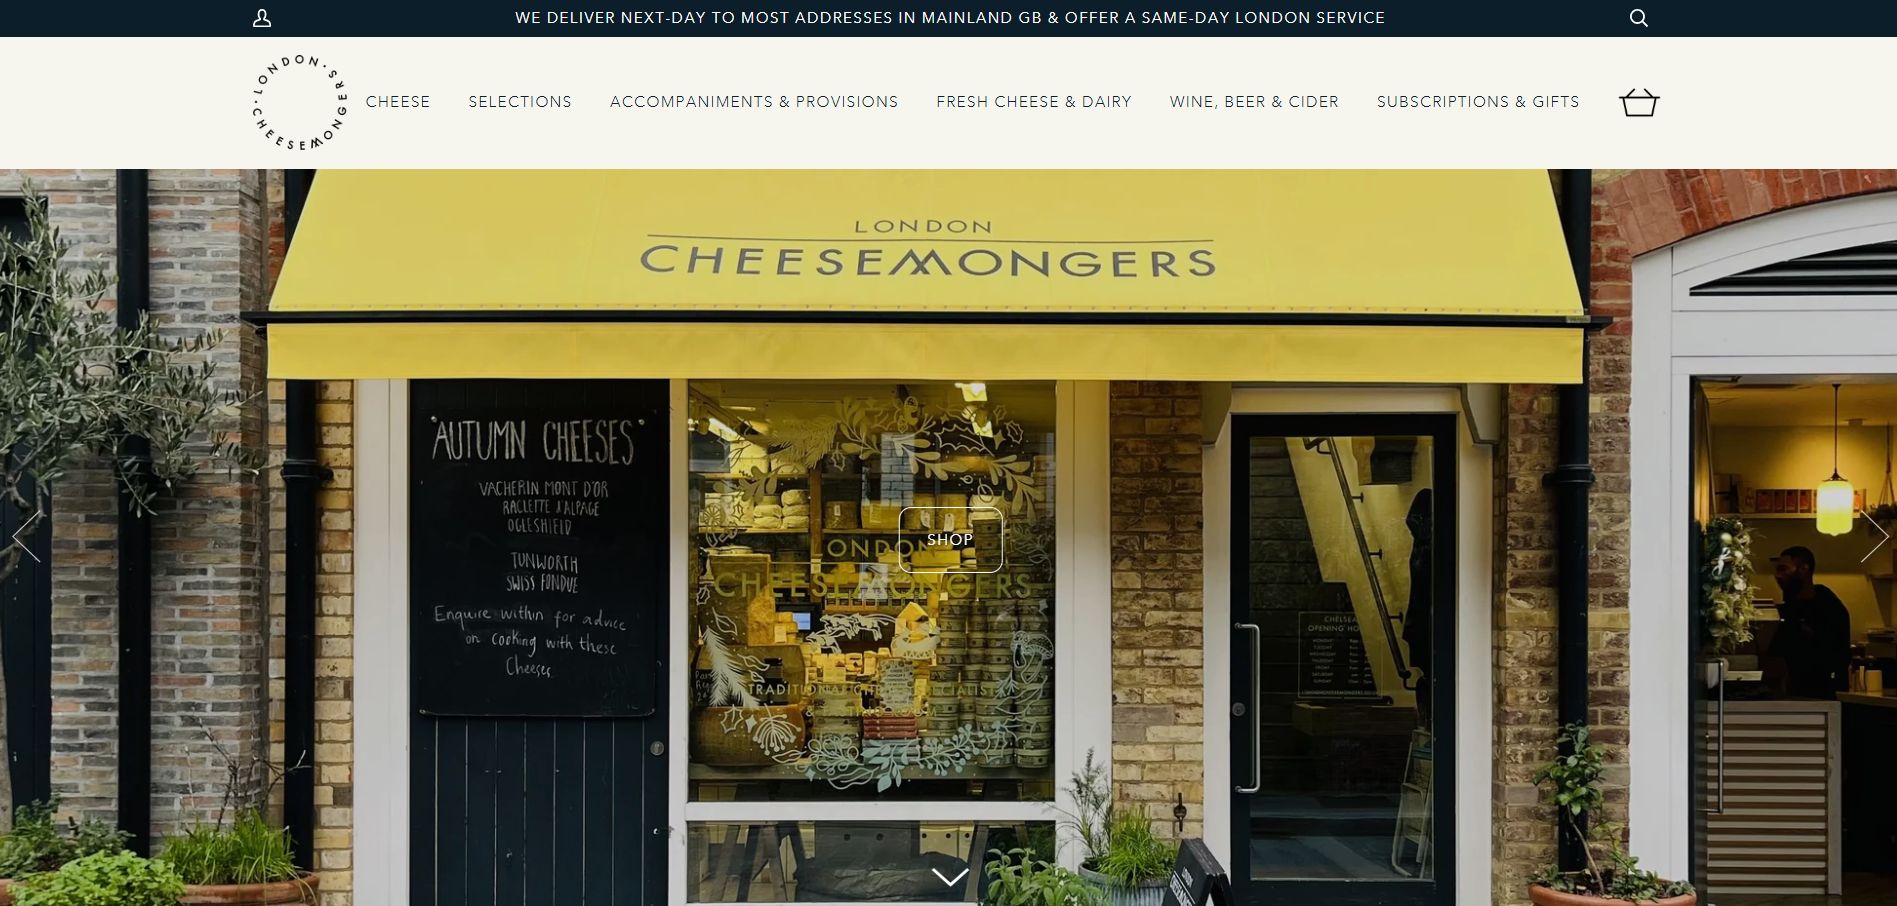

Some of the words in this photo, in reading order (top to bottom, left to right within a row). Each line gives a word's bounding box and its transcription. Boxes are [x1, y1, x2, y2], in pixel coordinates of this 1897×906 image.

[855, 219, 992, 234] LONDON
[640, 244, 1217, 278] CHEESEMONGERS
[432, 420, 526, 460] AUTUMN
[543, 419, 634, 466] CHEESES
[479, 480, 539, 496] VACHERIN
[545, 481, 578, 496] MONT
[583, 481, 609, 498] D'OR
[503, 499, 550, 515] RACLETTE
[508, 518, 572, 535] OGLESHIELD
[511, 551, 578, 574] TUNWORTH
[506, 575, 535, 592] SWISS
[541, 573, 578, 594] FONDUE
[434, 604, 492, 631] Enquire
[500, 604, 544, 621] within
[554, 610, 576, 629] for
[582, 609, 627, 631] advice
[465, 634, 480, 645] on
[546, 634, 574, 650] with
[579, 633, 617, 655] these
